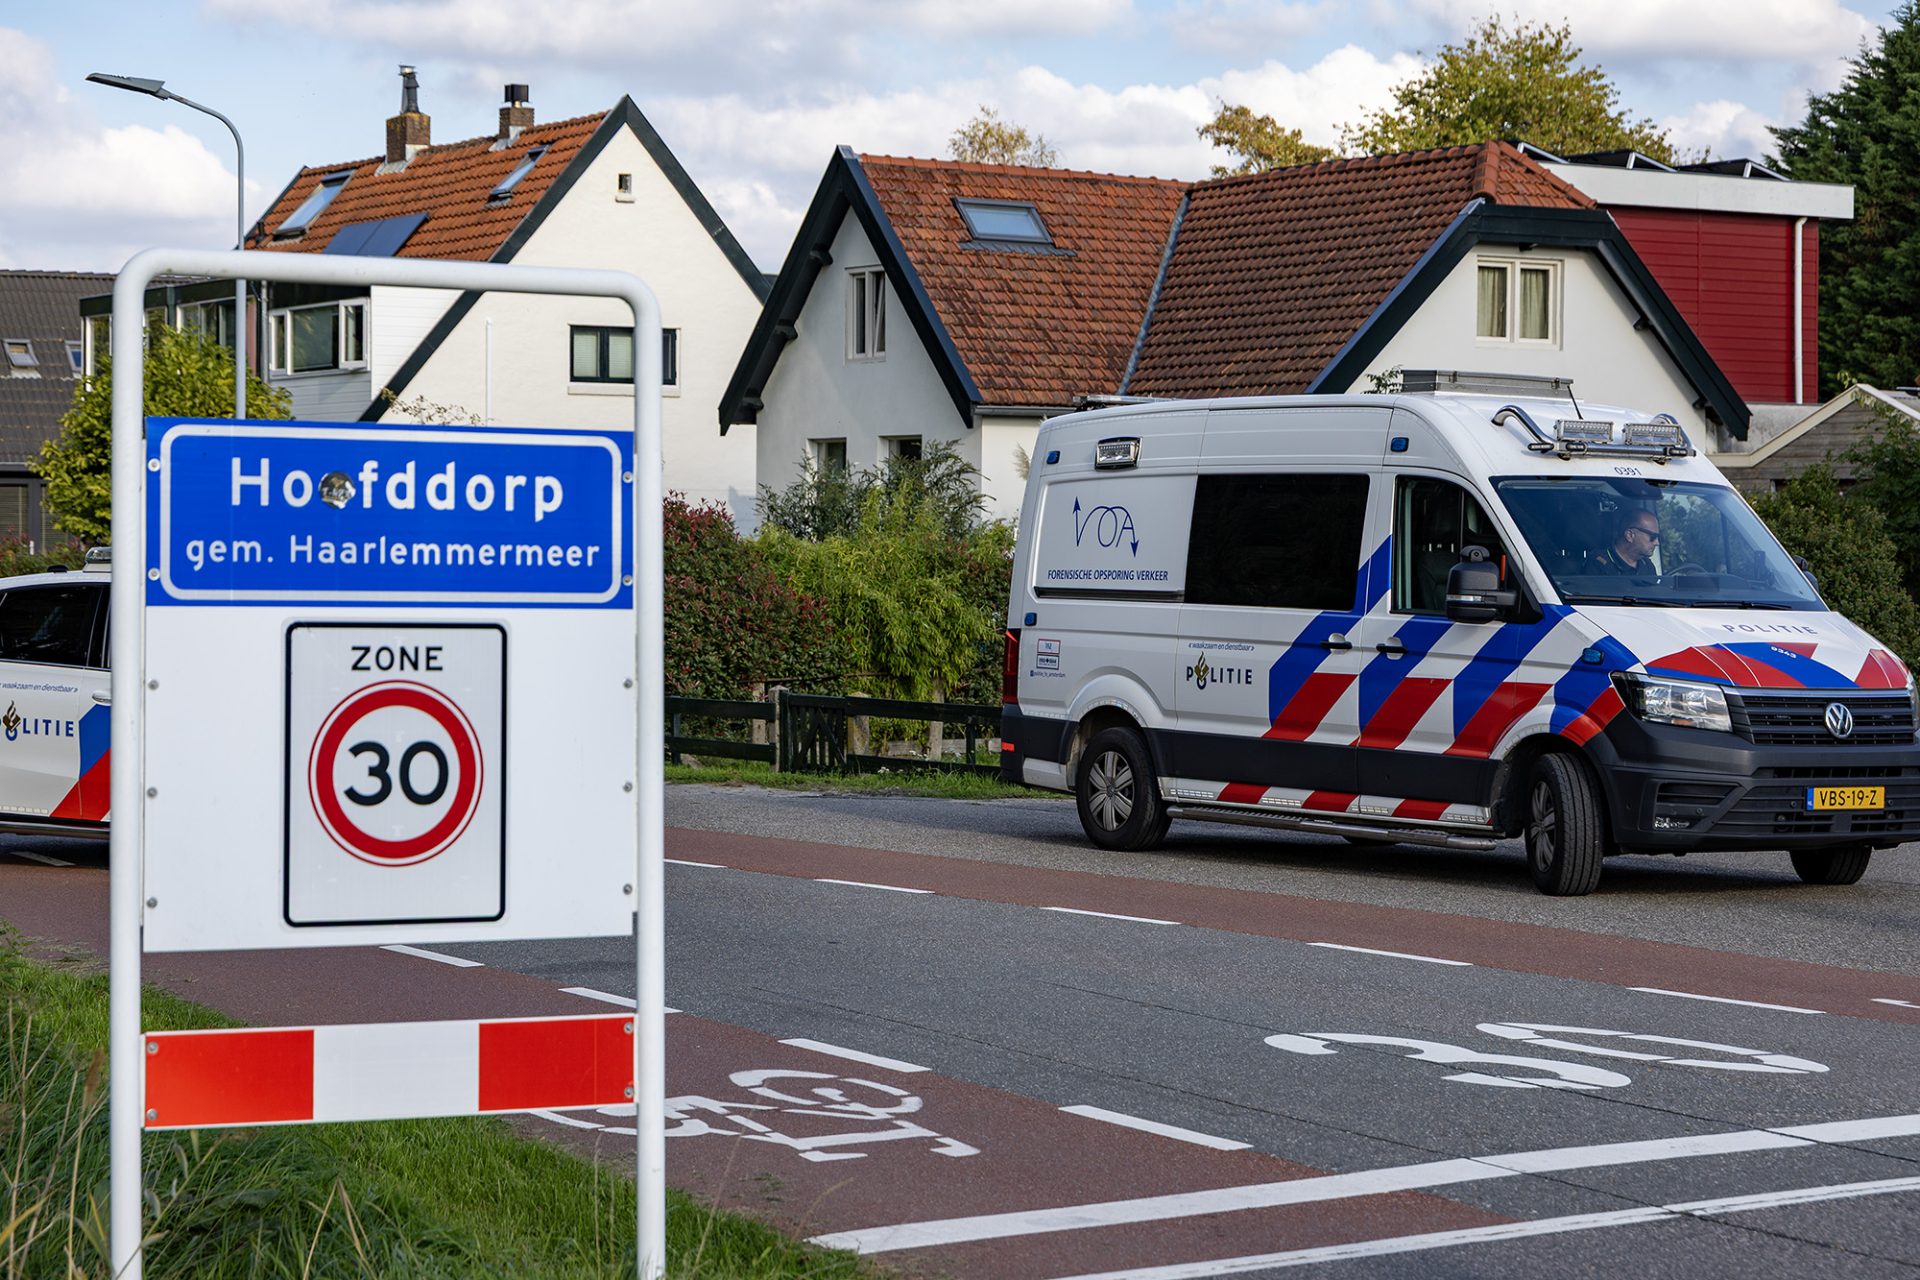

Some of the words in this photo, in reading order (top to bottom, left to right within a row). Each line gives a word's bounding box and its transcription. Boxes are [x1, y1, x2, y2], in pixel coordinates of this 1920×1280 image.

[1614, 466, 1642, 476] 0391
[231, 457, 564, 522] Hofddorp
[1073, 497, 1139, 558] VOA
[185, 538, 274, 572] gem.
[289, 534, 600, 567] Haarlemmermeer
[1047, 569, 1092, 580] FORENSISCHE
[1093, 569, 1135, 581] OPSPORING
[1136, 570, 1169, 581] VERKEER
[1721, 624, 1818, 635] POLITIE
[351, 646, 444, 672] ZONE
[1186, 665, 1253, 690] POLITIE
[0, 717, 75, 742] OLITIE
[343, 741, 450, 807] 30
[1819, 790, 1877, 806] VBS-19-Z
